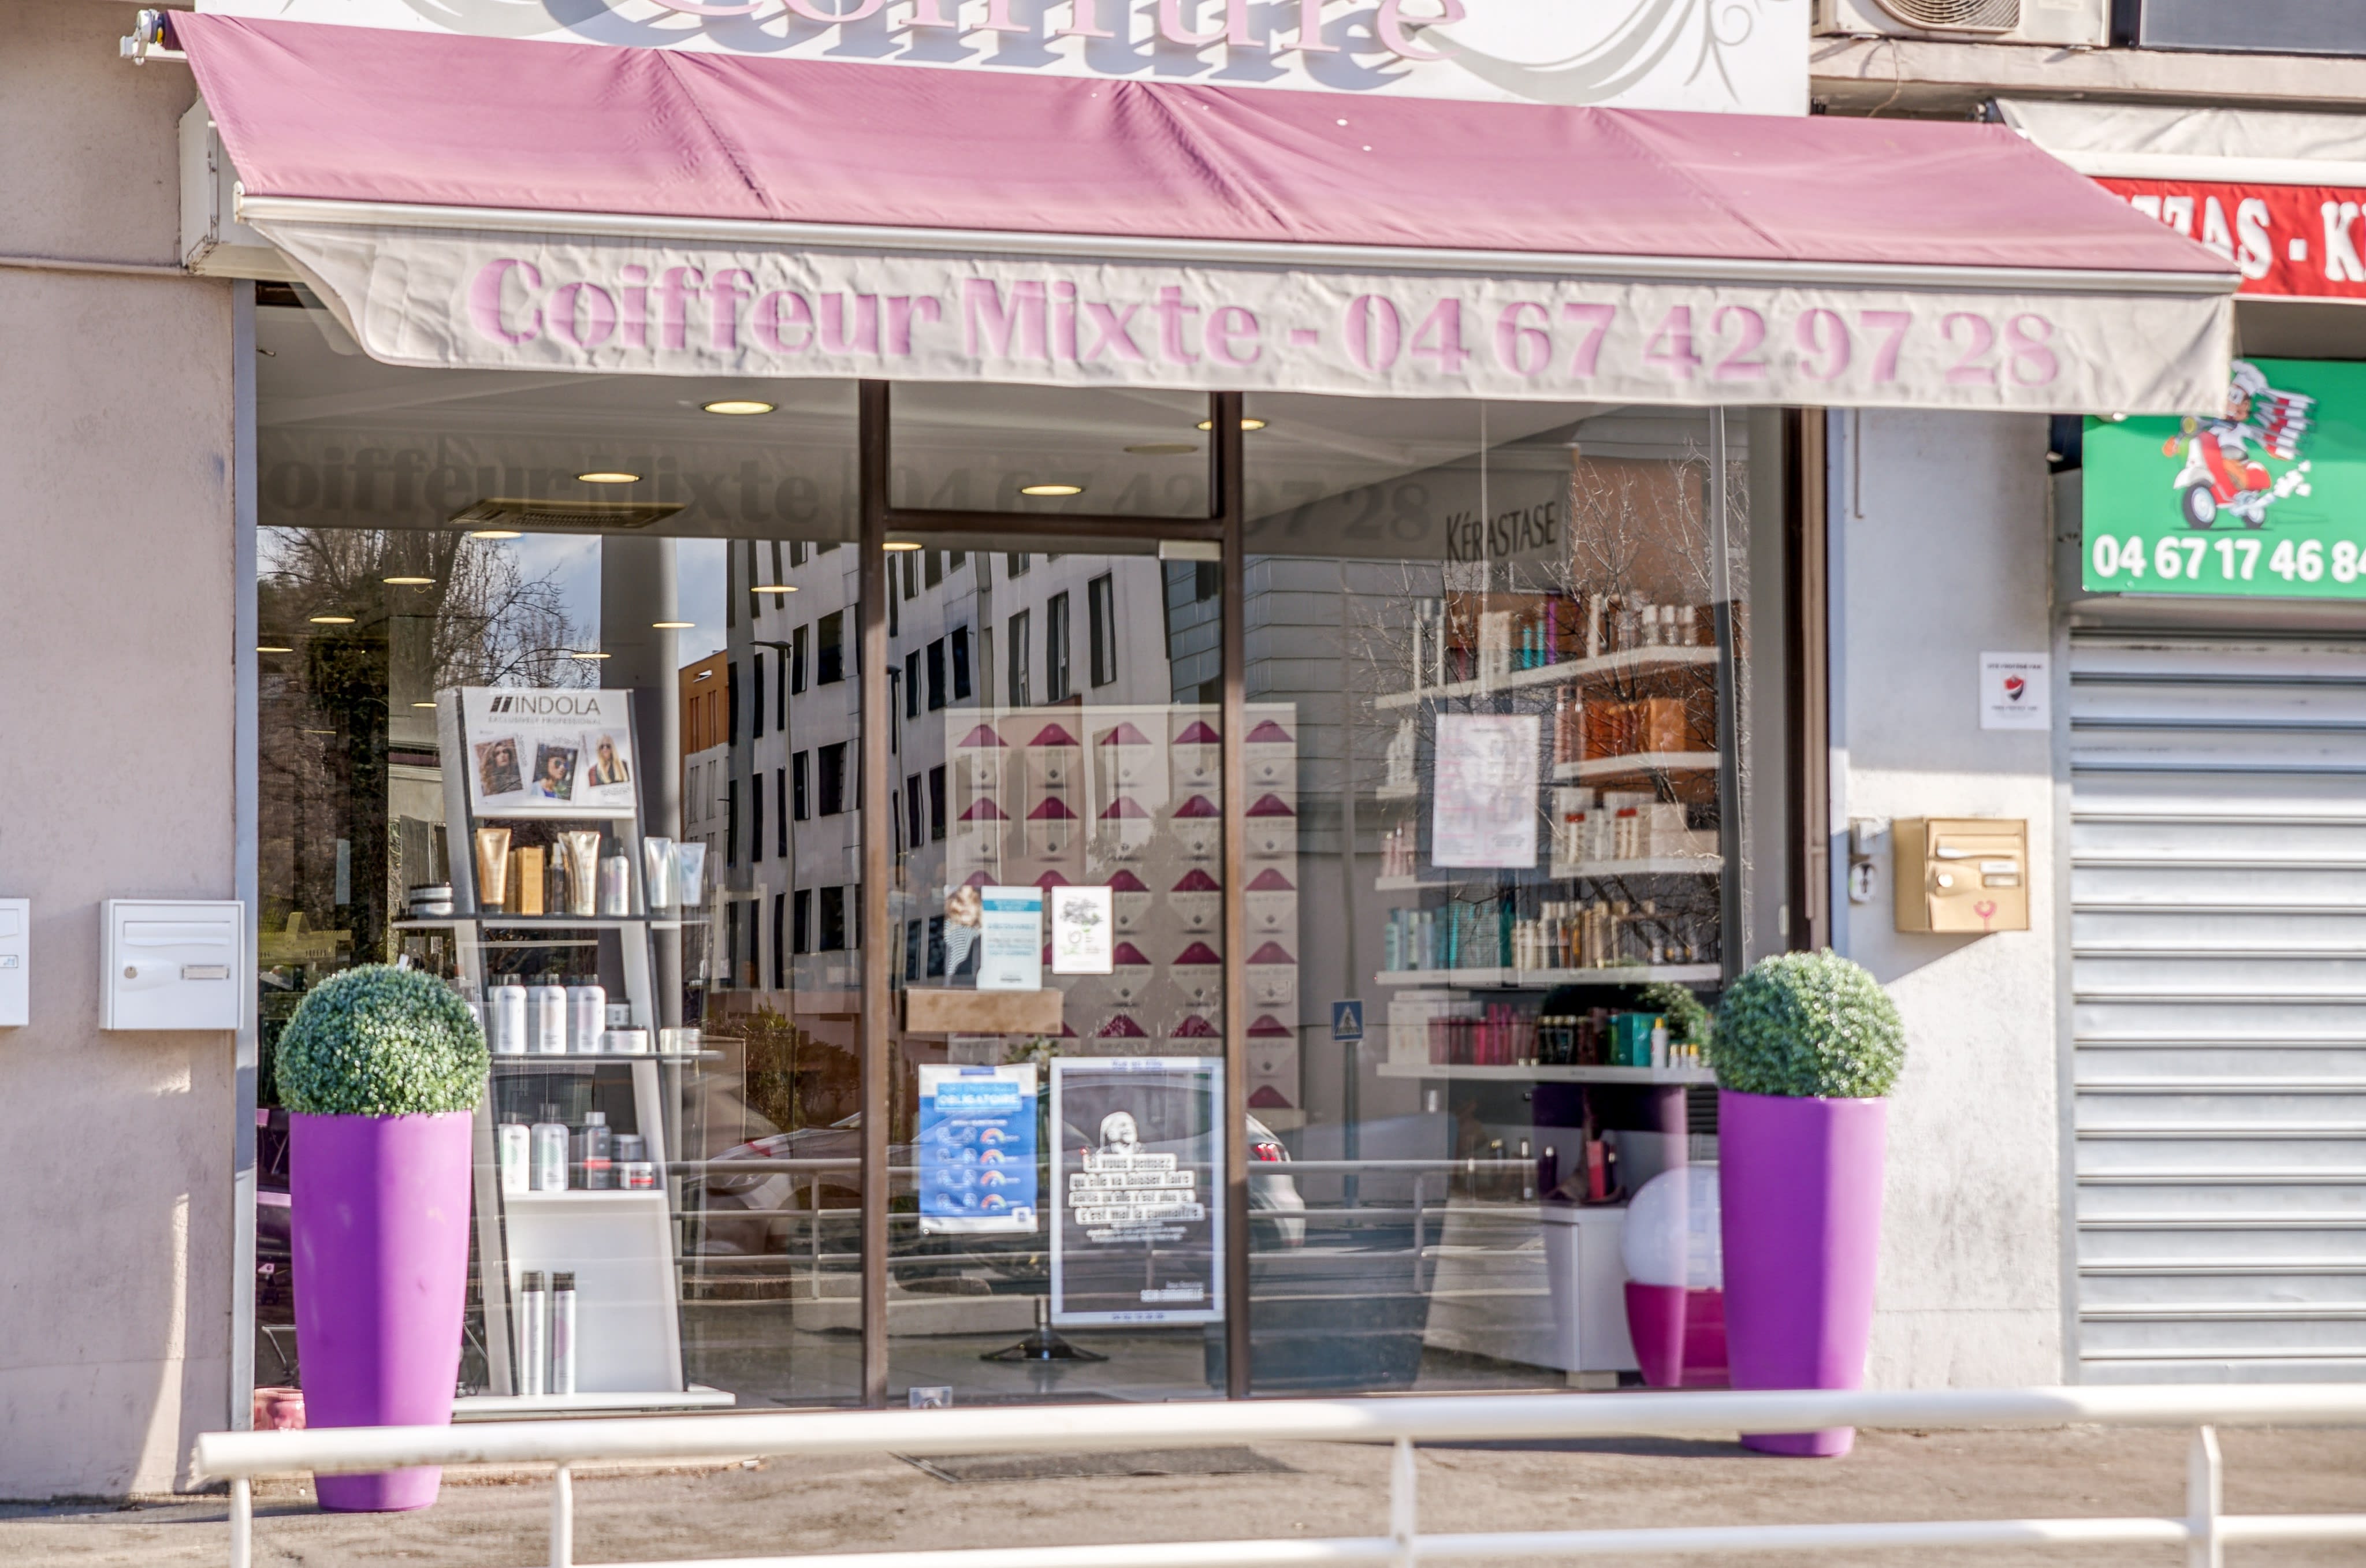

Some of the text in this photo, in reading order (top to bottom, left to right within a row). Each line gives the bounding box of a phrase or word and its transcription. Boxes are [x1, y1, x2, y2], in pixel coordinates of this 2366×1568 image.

[2321, 202, 2366, 282] K
[468, 258, 942, 356] Coiffeur
[964, 278, 1262, 367] Mixte
[1345, 293, 1470, 374] 04
[1494, 301, 1617, 378] 67
[1643, 306, 1768, 381] 42
[1795, 308, 1913, 383] 97
[1940, 312, 2060, 388] 28
[2092, 534, 2146, 578] 04
[2154, 537, 2207, 580] 67
[2214, 538, 2262, 580] 17
[2269, 539, 2324, 582] 46
[515, 695, 601, 715] INDOLA
